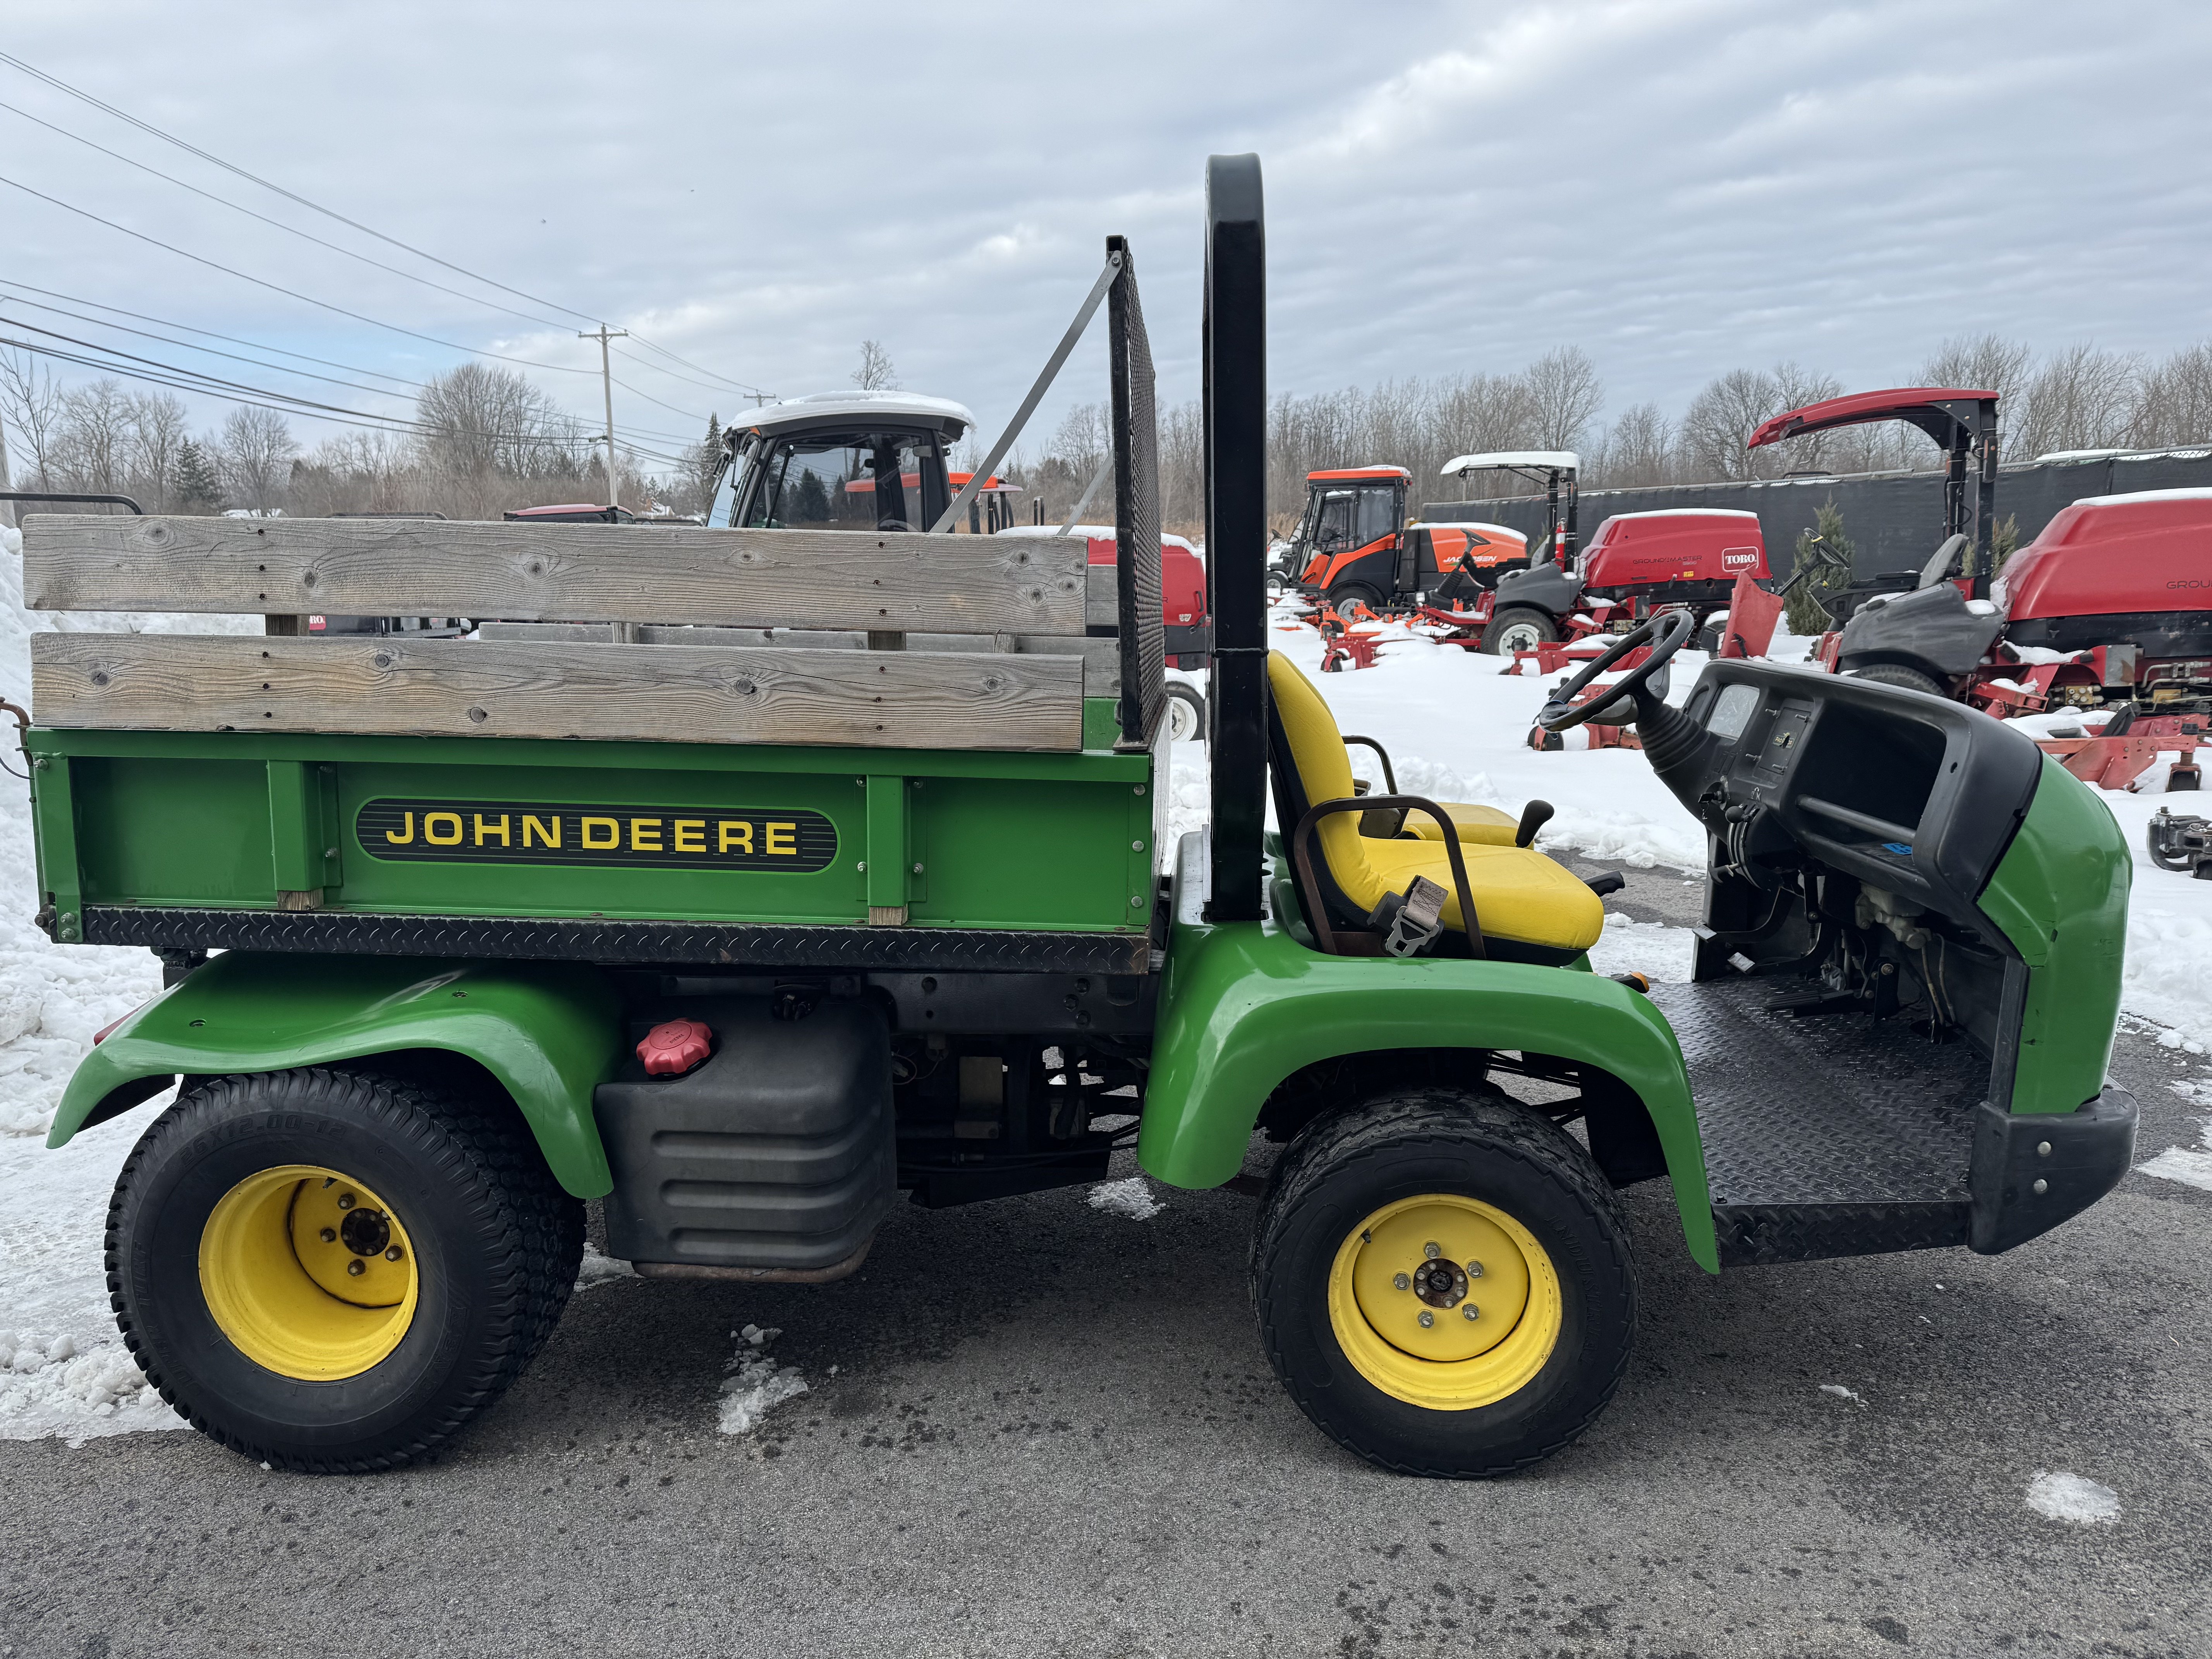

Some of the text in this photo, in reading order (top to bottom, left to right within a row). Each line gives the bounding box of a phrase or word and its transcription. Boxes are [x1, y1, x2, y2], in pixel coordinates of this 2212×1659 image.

[1725, 554, 1755, 564] TORO
[2166, 580, 2212, 589] GROU
[309, 615, 323, 624] RO
[386, 812, 797, 854] JOHN DEERE
[670, 1034, 684, 1044] DIESEL
[180, 1114, 348, 1166] 26X12.00-12
[1544, 1215, 1602, 1369] INDUSTRIAL
